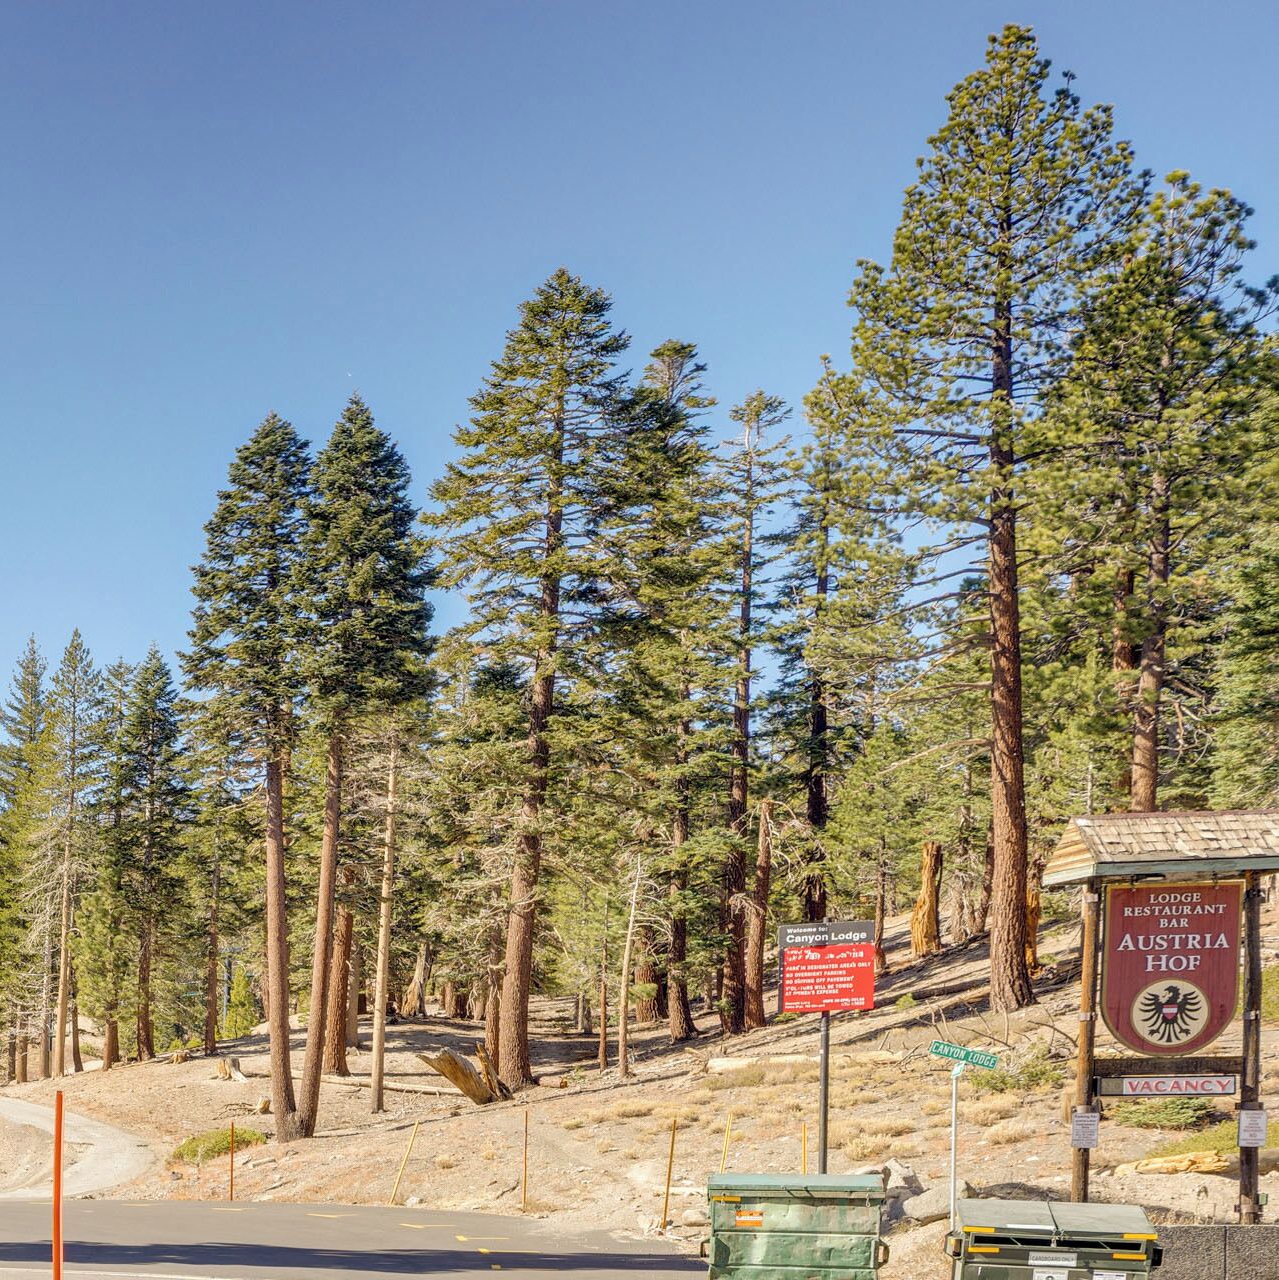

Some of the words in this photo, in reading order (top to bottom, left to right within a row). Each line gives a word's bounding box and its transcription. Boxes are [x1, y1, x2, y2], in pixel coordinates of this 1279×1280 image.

[1149, 892, 1201, 904] LODGE
[1123, 904, 1227, 917] RESTAURANT
[1159, 918, 1189, 928] BAR
[786, 934, 829, 943] Canyon
[831, 931, 867, 941] Lodge
[1116, 932, 1230, 951] AUSTRIA
[1144, 954, 1201, 972] HOF
[931, 1042, 967, 1060] CANYON
[968, 1050, 997, 1067] LODGE
[1127, 1079, 1231, 1093] VACANCY
